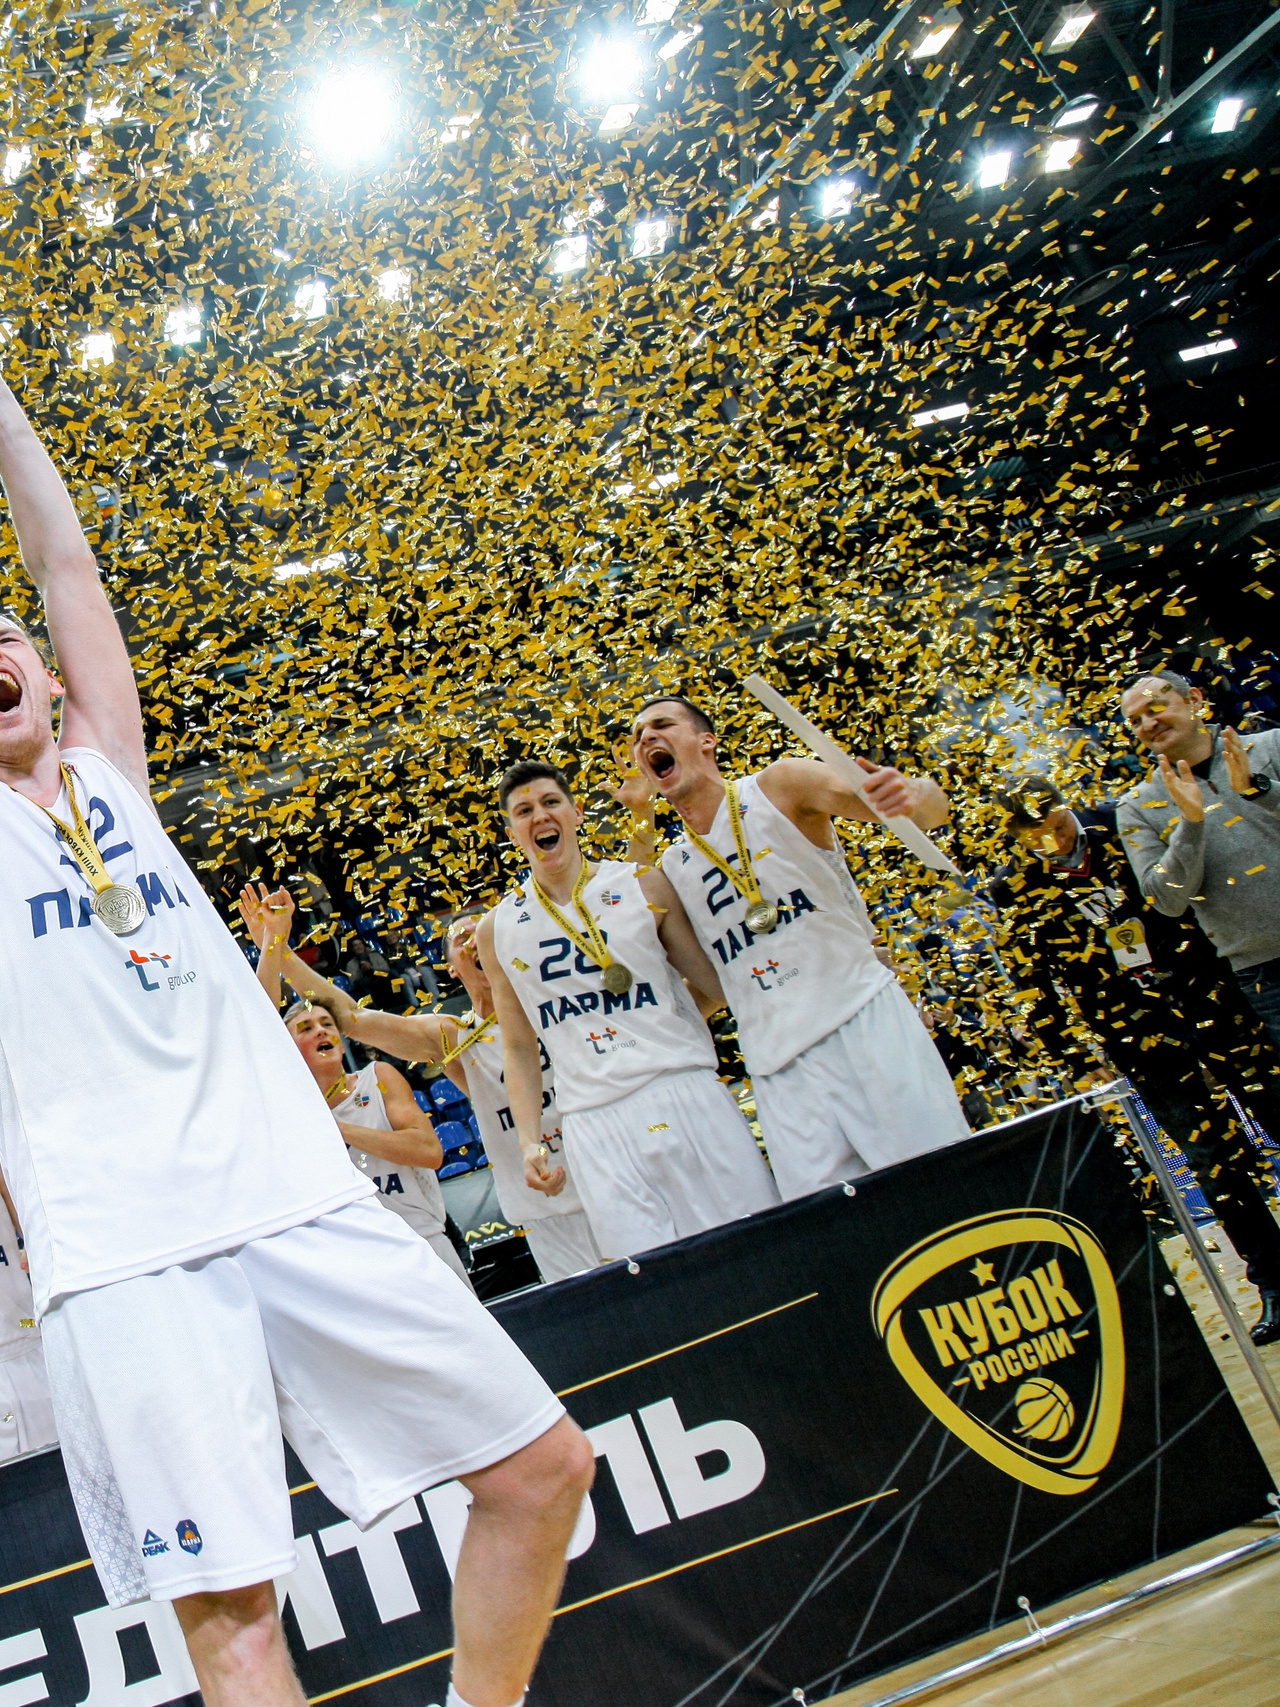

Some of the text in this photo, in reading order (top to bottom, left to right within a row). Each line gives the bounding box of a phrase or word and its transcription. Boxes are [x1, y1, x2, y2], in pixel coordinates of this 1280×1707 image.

[64, 832, 84, 857] КУБОК
[81, 856, 97, 876] XVIII
[776, 967, 800, 987] group
[538, 982, 659, 1029] ПАРМА
[611, 1040, 637, 1052] group
[918, 1258, 1084, 1368] КУБОК
[967, 1330, 1077, 1391] РОССИИ
[141, 1541, 171, 1557] PEAK
